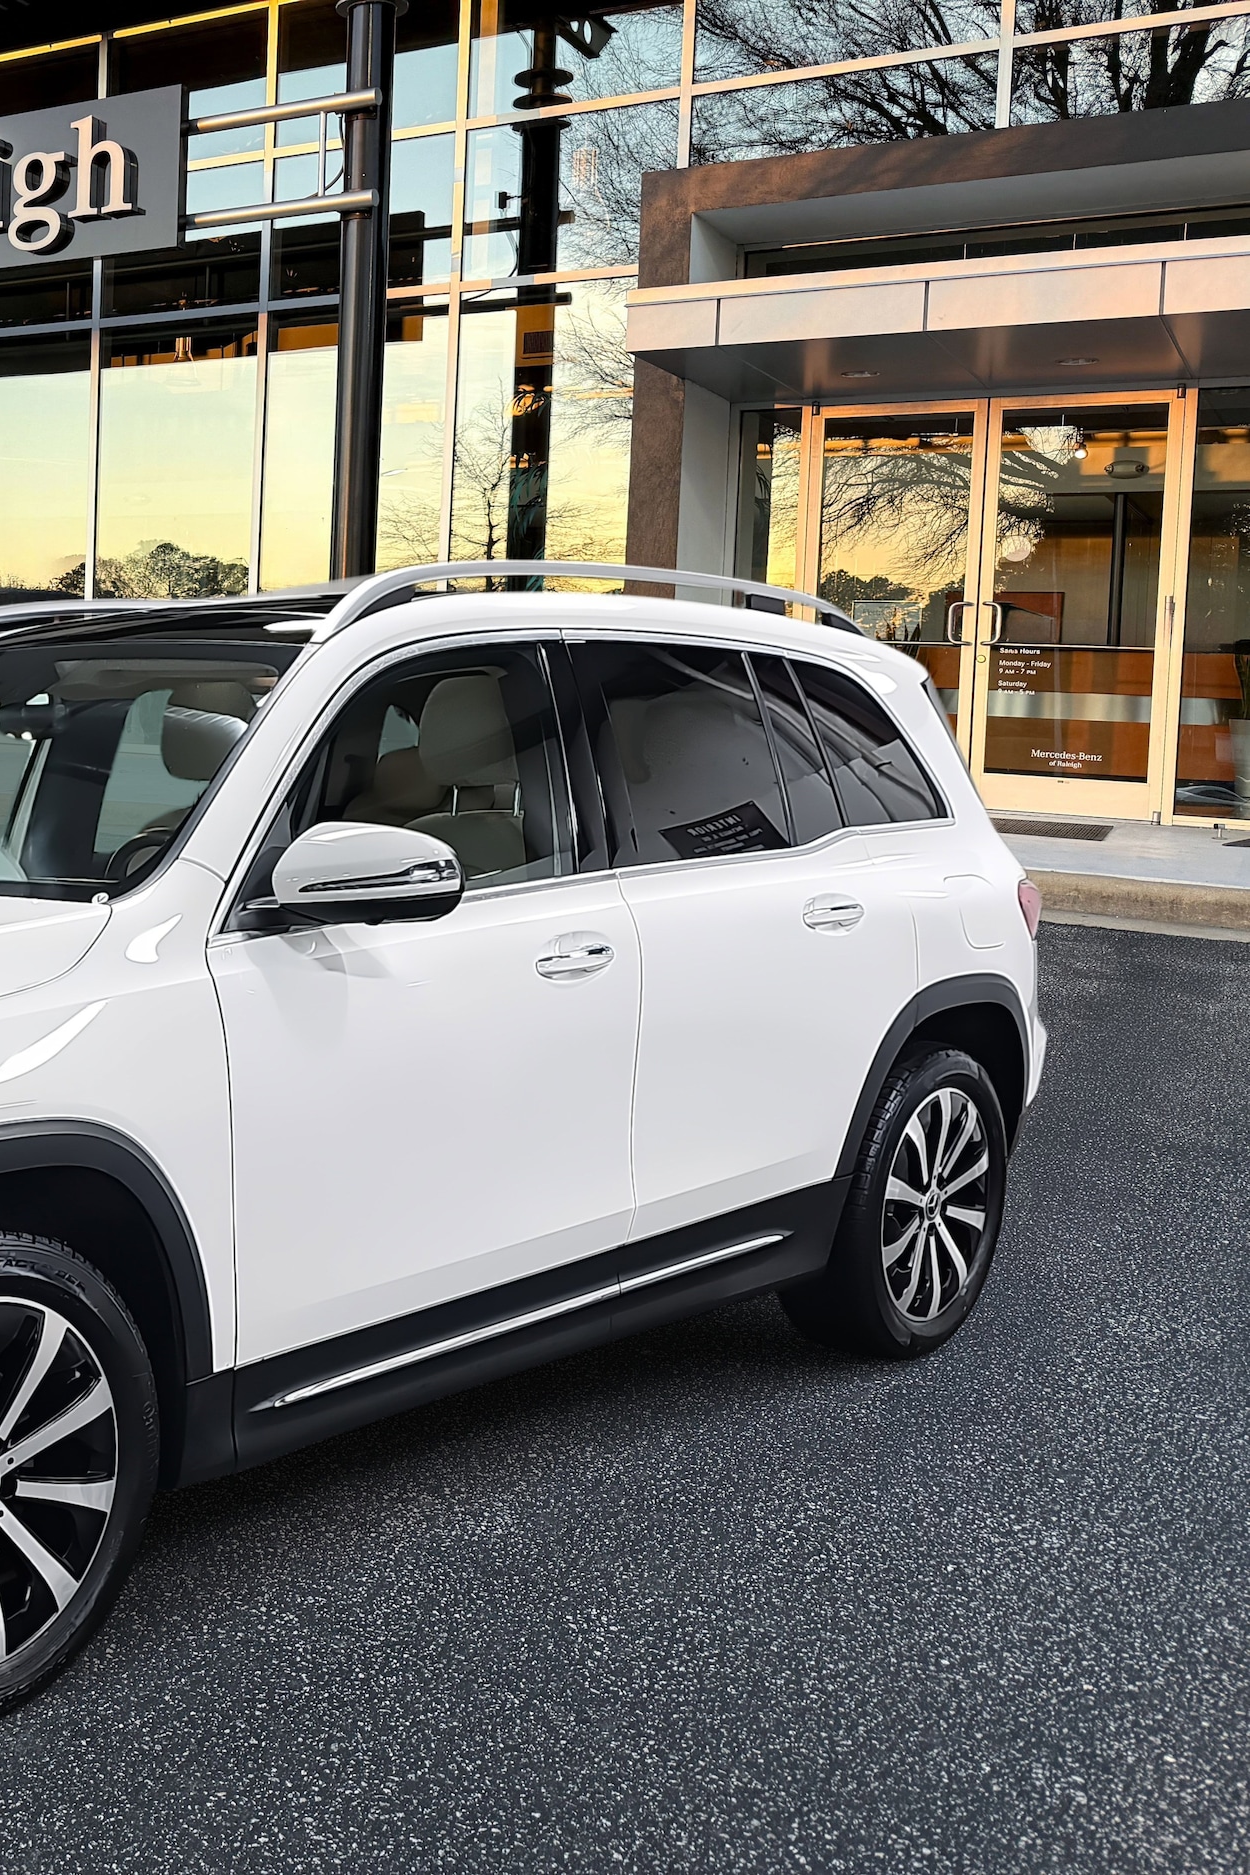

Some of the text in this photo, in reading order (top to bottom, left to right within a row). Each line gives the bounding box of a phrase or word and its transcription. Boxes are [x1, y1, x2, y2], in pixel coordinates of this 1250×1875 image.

[998, 660, 1025, 668] Monday
[1030, 661, 1052, 669] Friday
[997, 680, 1028, 688] Saturday
[1031, 748, 1103, 762] Mercedes-Benz
[1057, 761, 1082, 769] Raleigh
